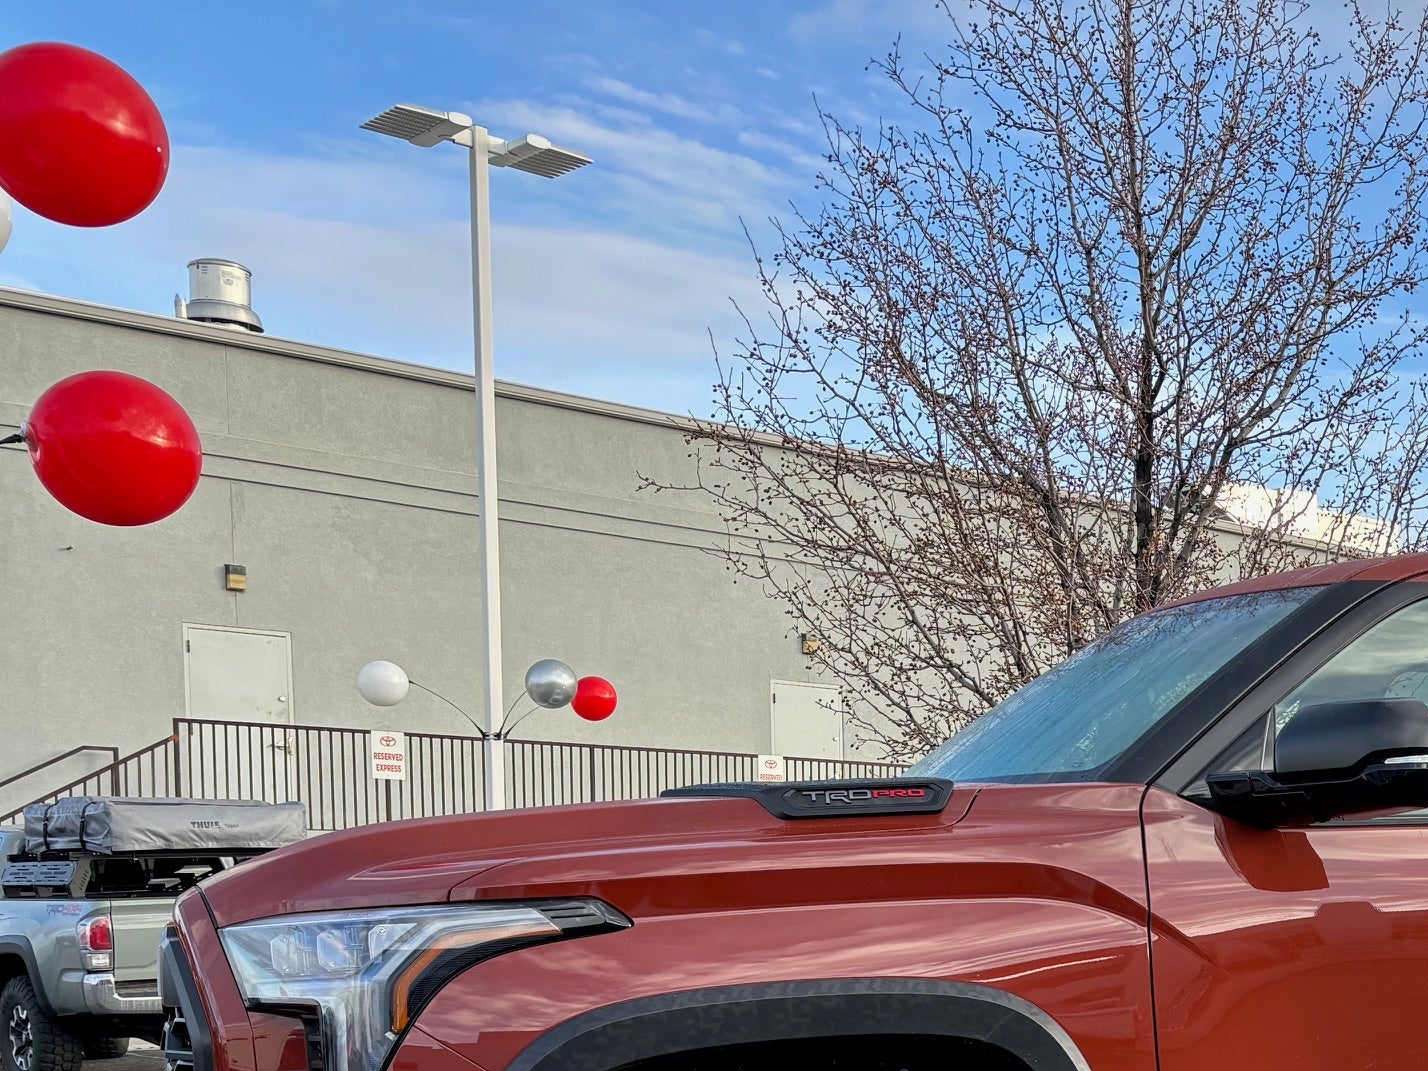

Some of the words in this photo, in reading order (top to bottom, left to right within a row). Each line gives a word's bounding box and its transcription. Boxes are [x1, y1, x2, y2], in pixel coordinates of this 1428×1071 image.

[373, 752, 404, 761] RESERVED
[376, 763, 402, 772] EXPRESS
[802, 789, 872, 805] TRD
[872, 788, 926, 799] PRO
